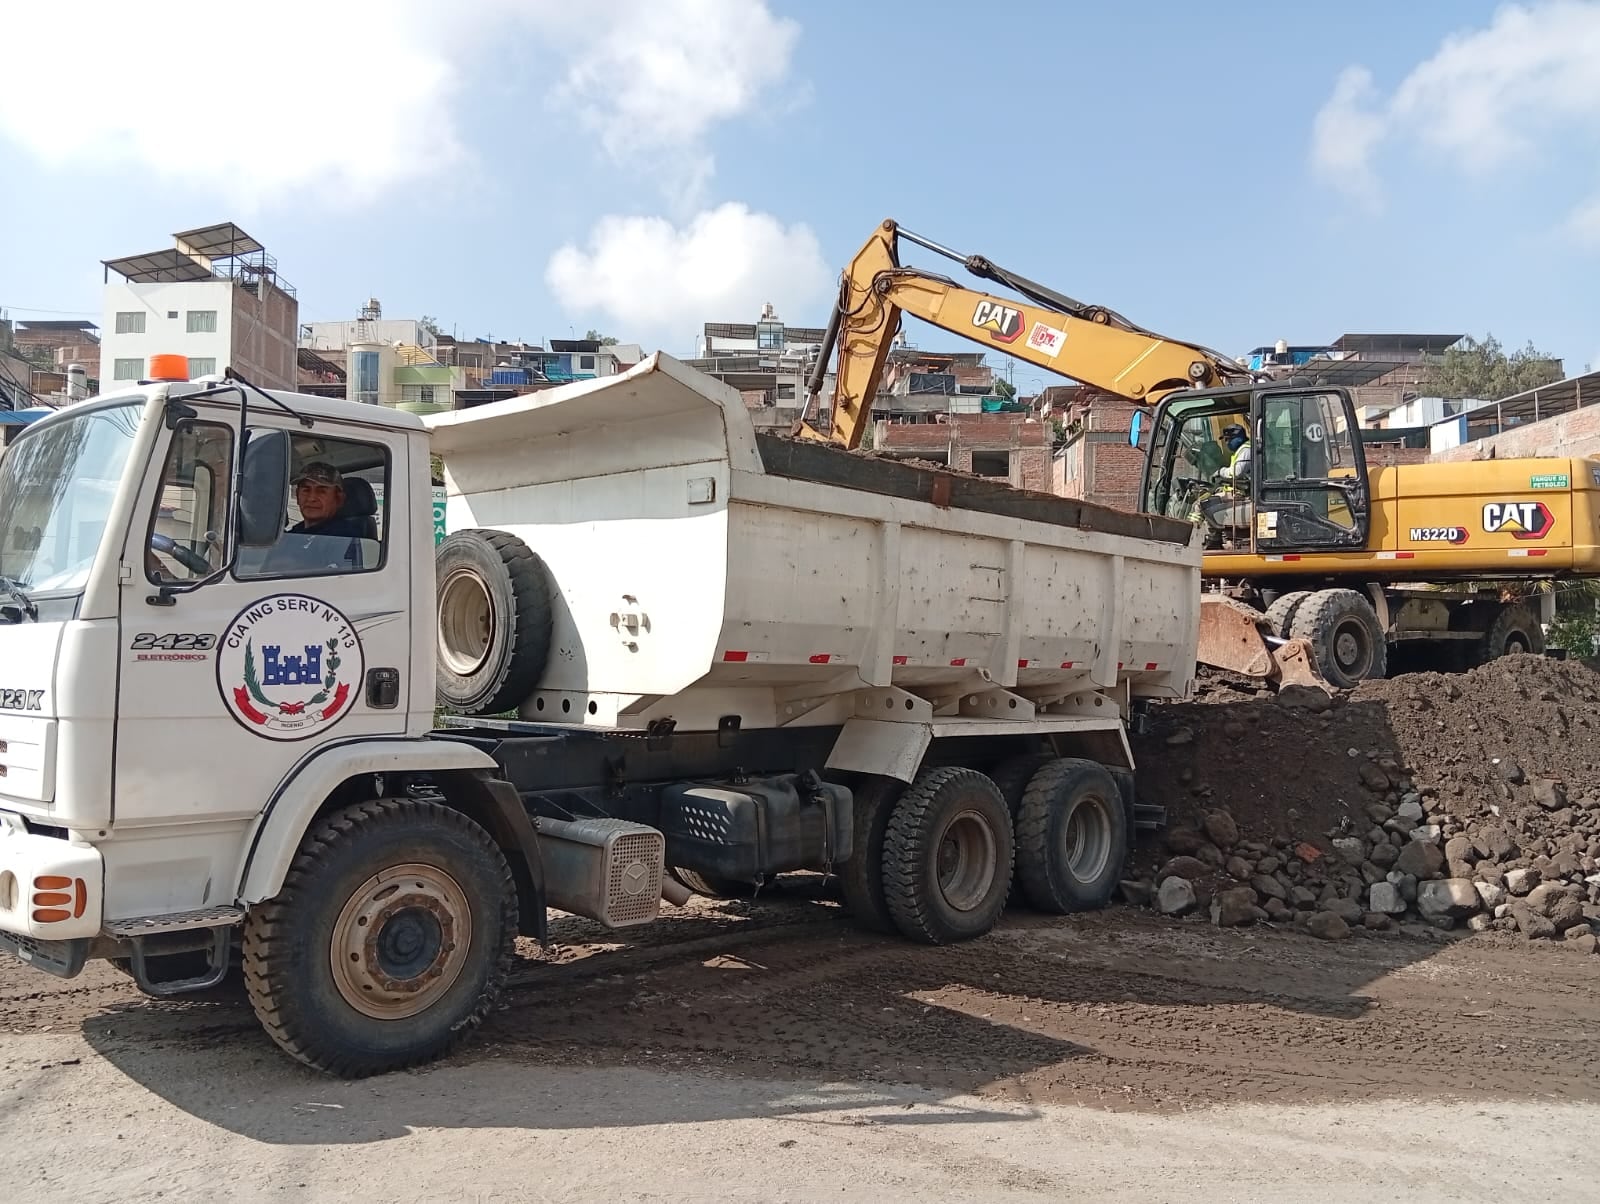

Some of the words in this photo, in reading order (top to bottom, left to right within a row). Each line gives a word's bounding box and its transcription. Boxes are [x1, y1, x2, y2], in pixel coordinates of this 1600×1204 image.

[973, 301, 1018, 335] CAT
[1309, 426, 1323, 439] 10
[1483, 503, 1537, 532] CAT
[1410, 527, 1458, 541] M322D
[227, 624, 249, 649] CIA
[245, 603, 273, 625] ING
[276, 599, 320, 614] SERV
[337, 625, 355, 649] 113
[130, 633, 217, 650] 2423
